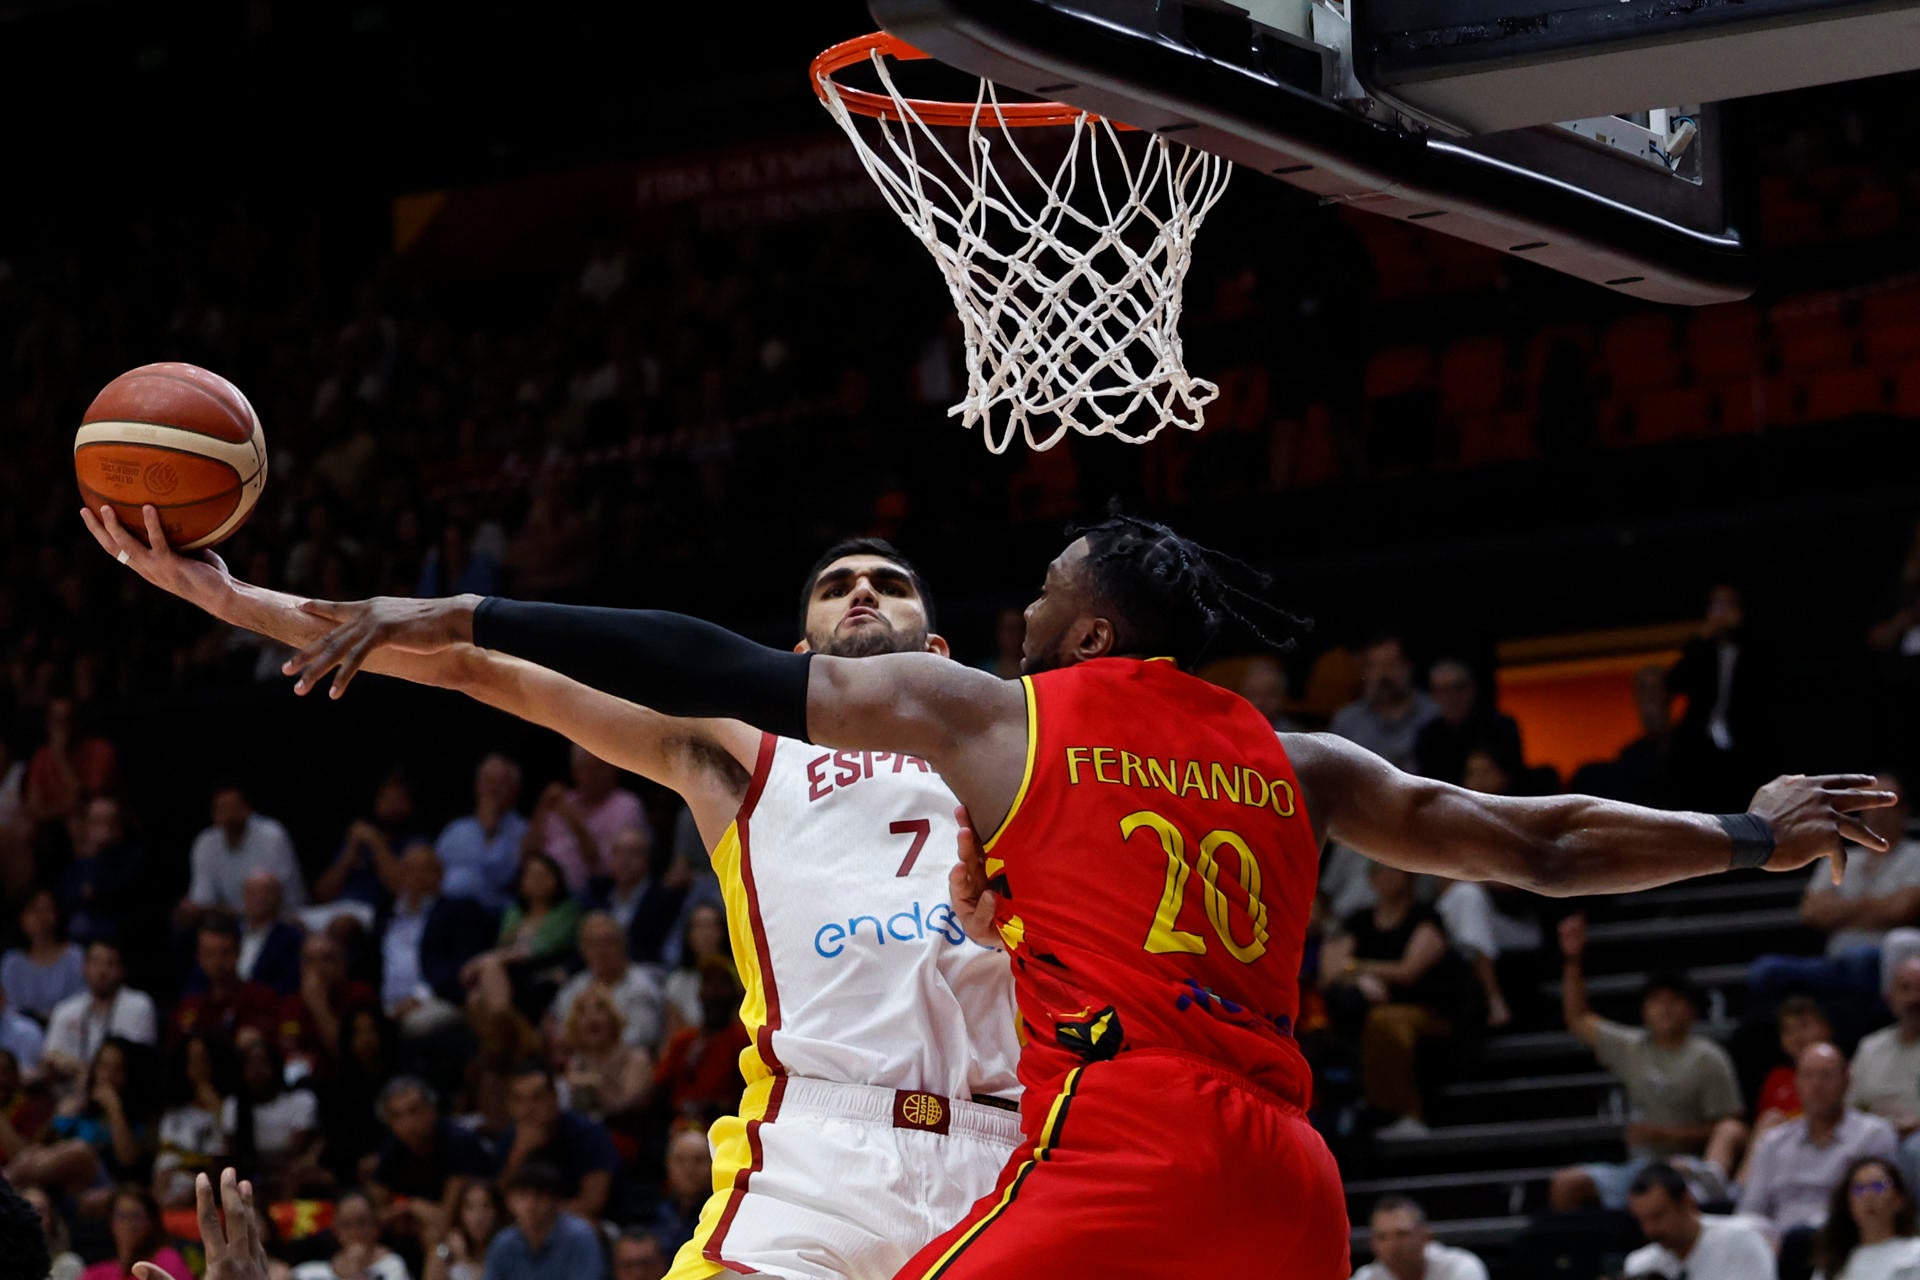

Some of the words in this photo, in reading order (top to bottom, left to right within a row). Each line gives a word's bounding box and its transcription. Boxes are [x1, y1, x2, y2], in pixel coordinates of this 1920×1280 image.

[806, 750, 936, 802] ESPA
[1065, 746, 1296, 817] FERNANDO
[888, 818, 931, 878] 7
[1118, 809, 1270, 964] 20
